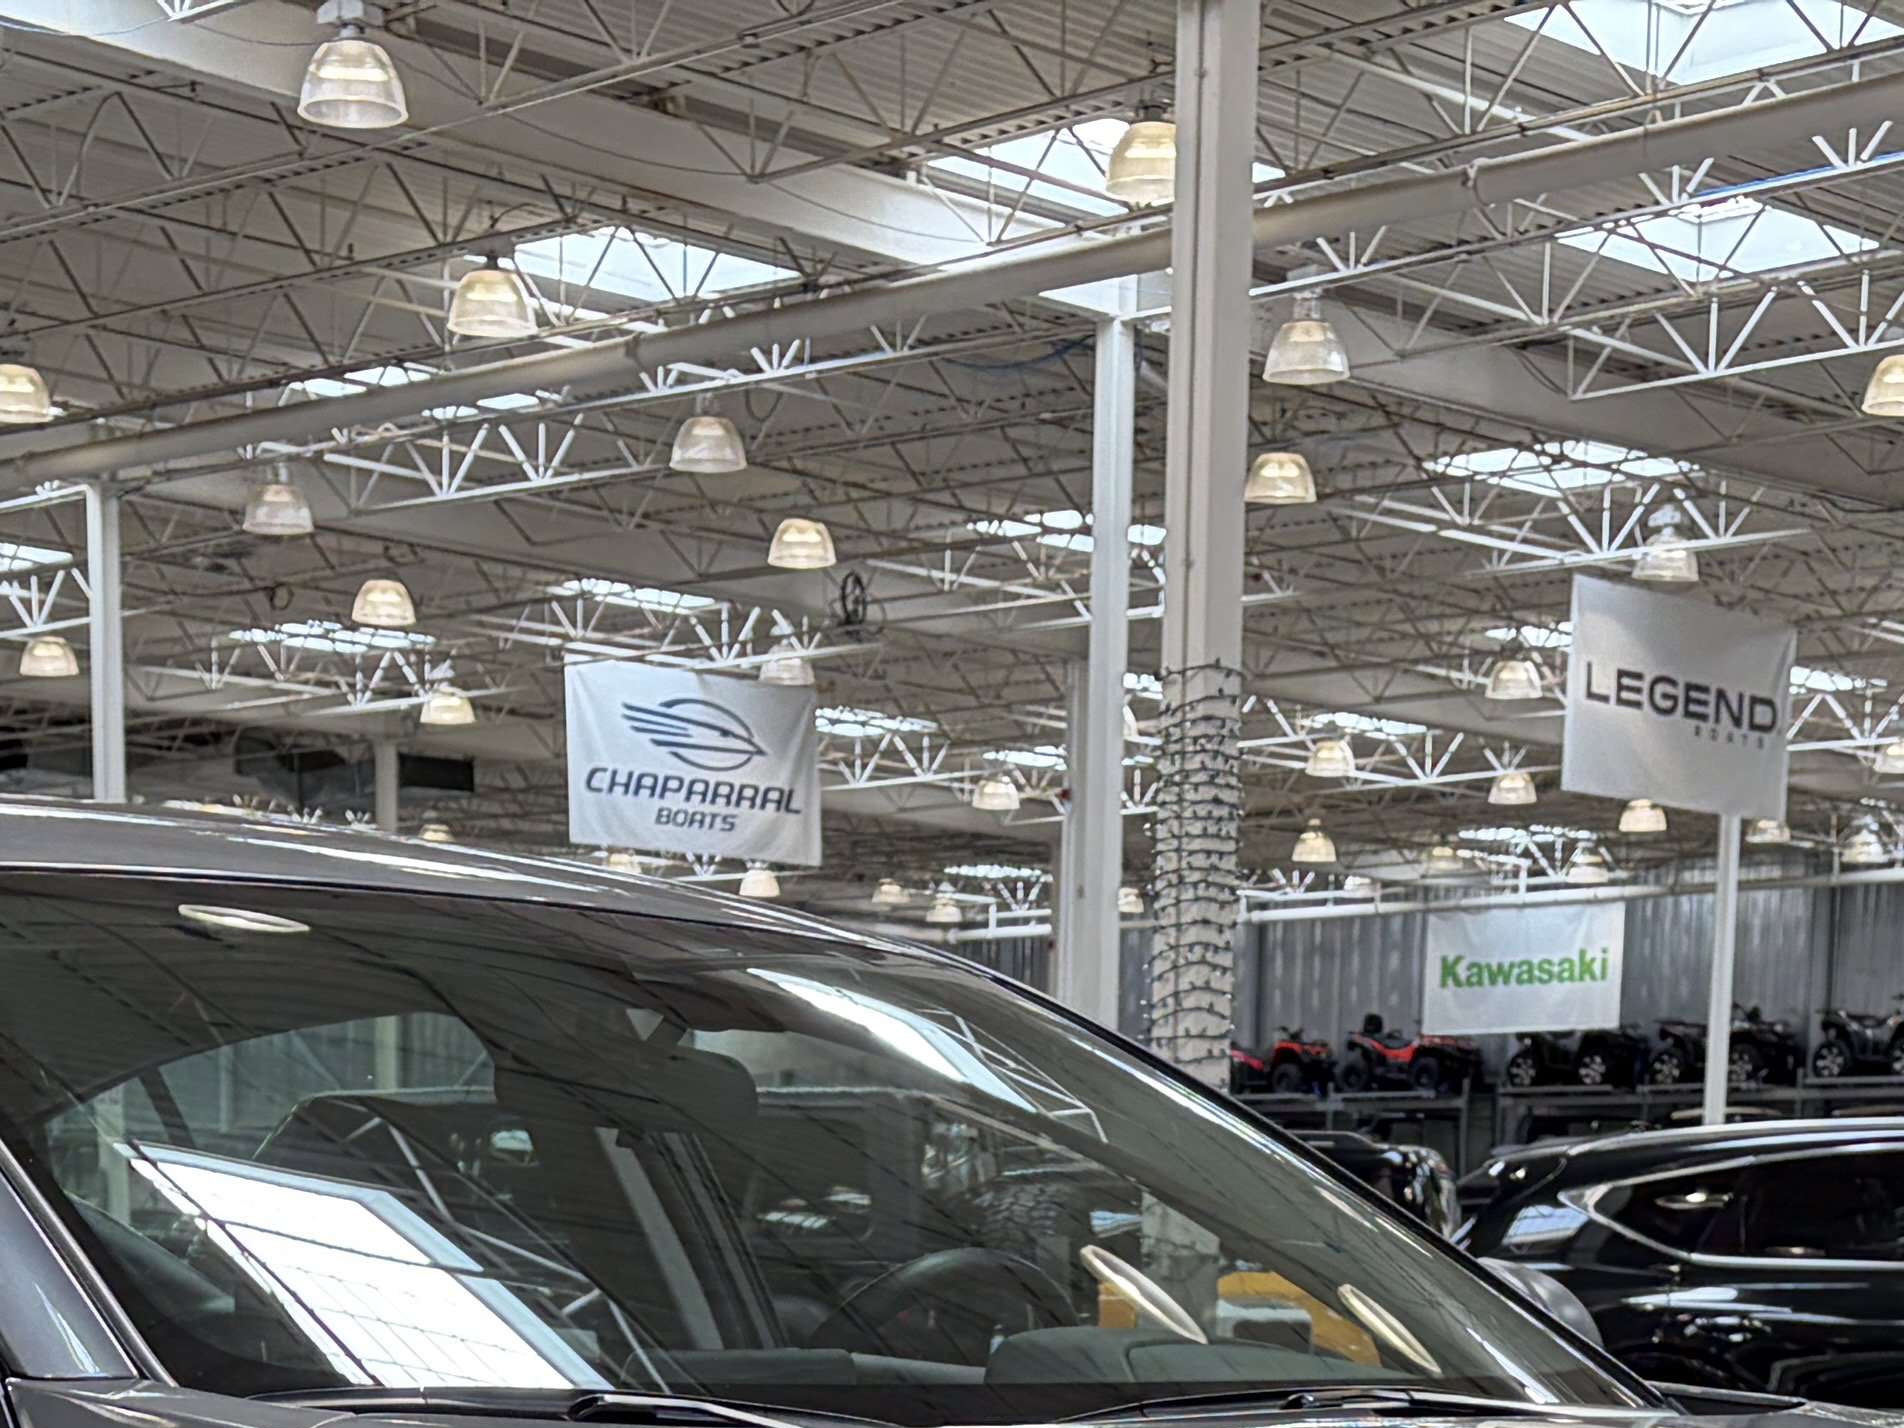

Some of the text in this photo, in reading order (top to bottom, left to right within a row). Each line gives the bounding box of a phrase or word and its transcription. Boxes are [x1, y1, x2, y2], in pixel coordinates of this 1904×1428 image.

[1586, 661, 1778, 734] LEGEND
[586, 767, 802, 815] CHAPARRAL
[654, 806, 738, 832] BOATS
[1440, 947, 1609, 989] Kawasaki
